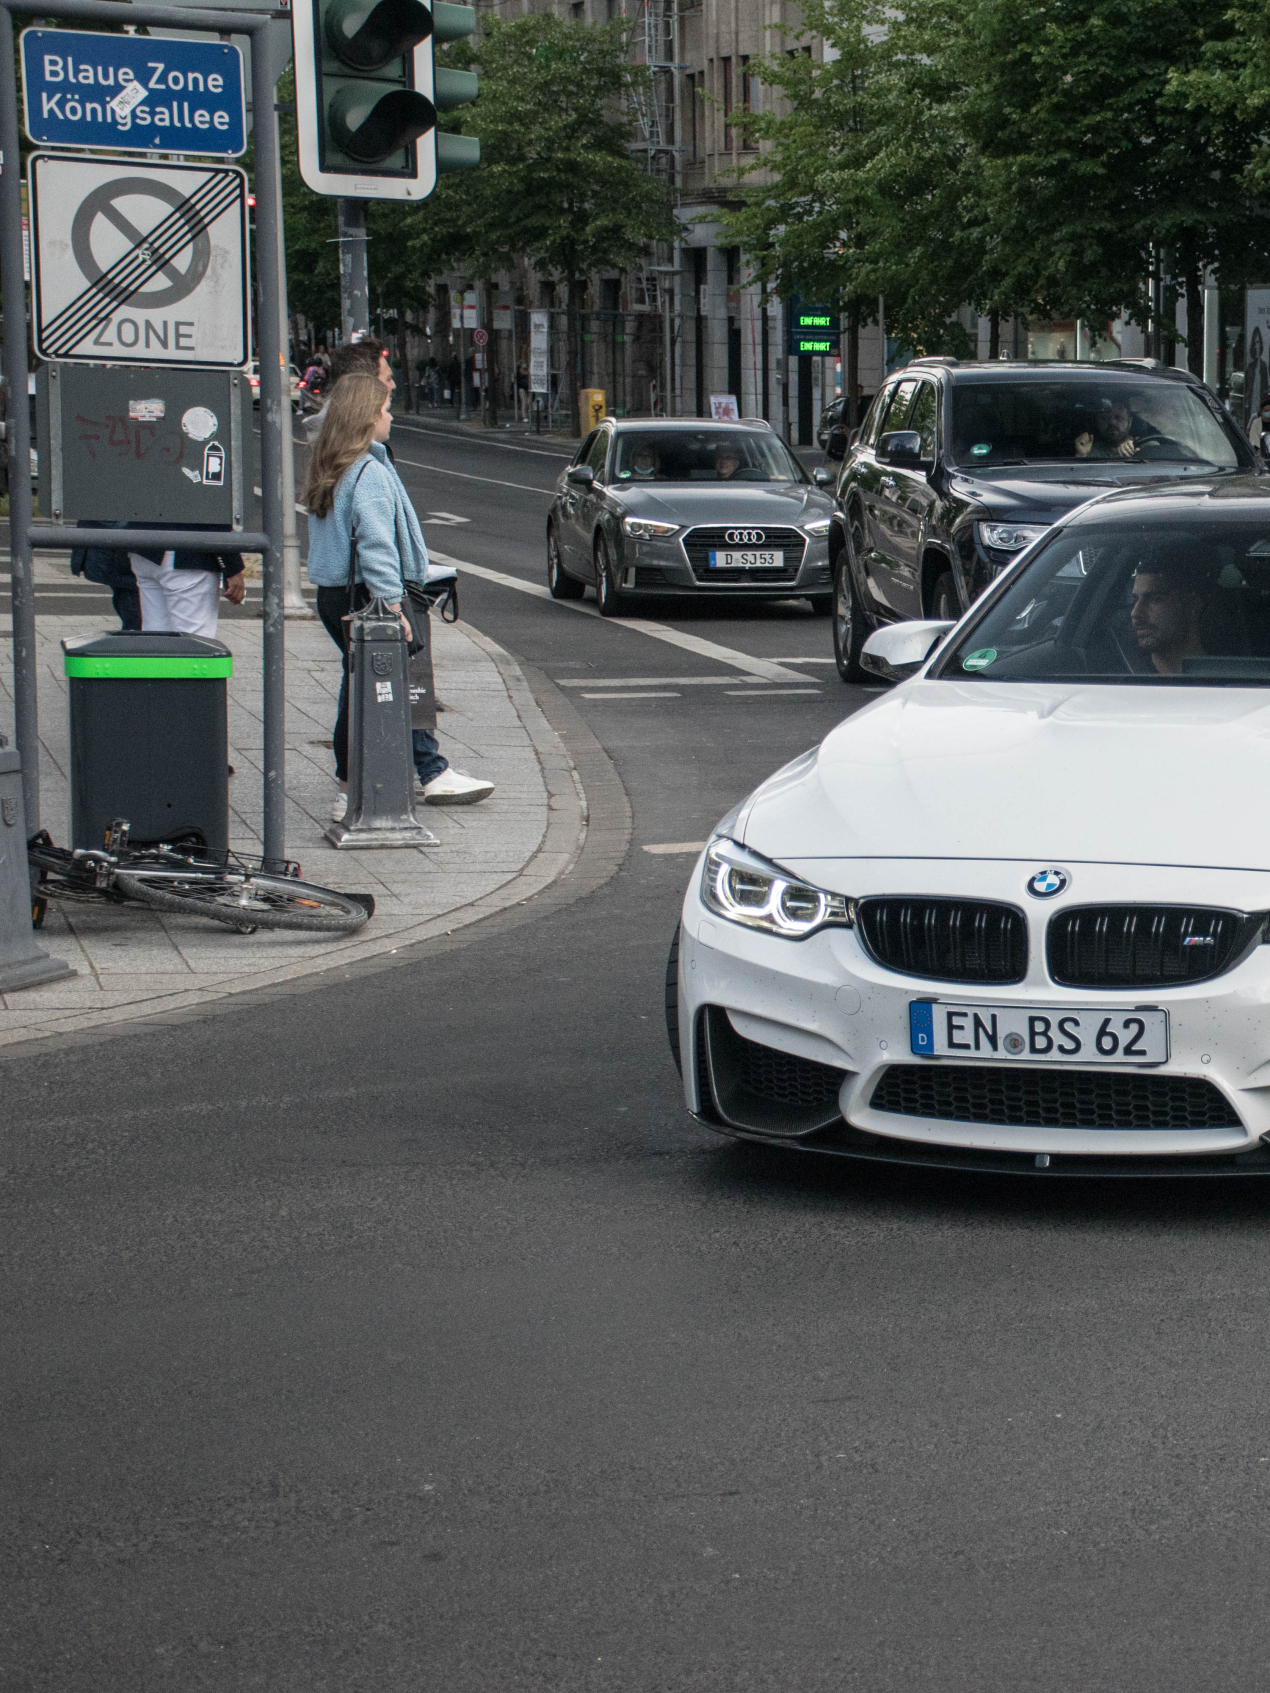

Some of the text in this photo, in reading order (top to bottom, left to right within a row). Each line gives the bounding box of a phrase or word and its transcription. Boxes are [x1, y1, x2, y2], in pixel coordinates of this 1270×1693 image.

[43, 54, 224, 93] Blaue Zone
[41, 92, 230, 131] Königsallee
[93, 316, 196, 351] ZONE
[800, 316, 831, 326] EINFAHRT
[800, 341, 831, 351] EINFAHRT
[725, 553, 733, 565] D
[918, 1010, 1148, 1057] D EN BS 62
